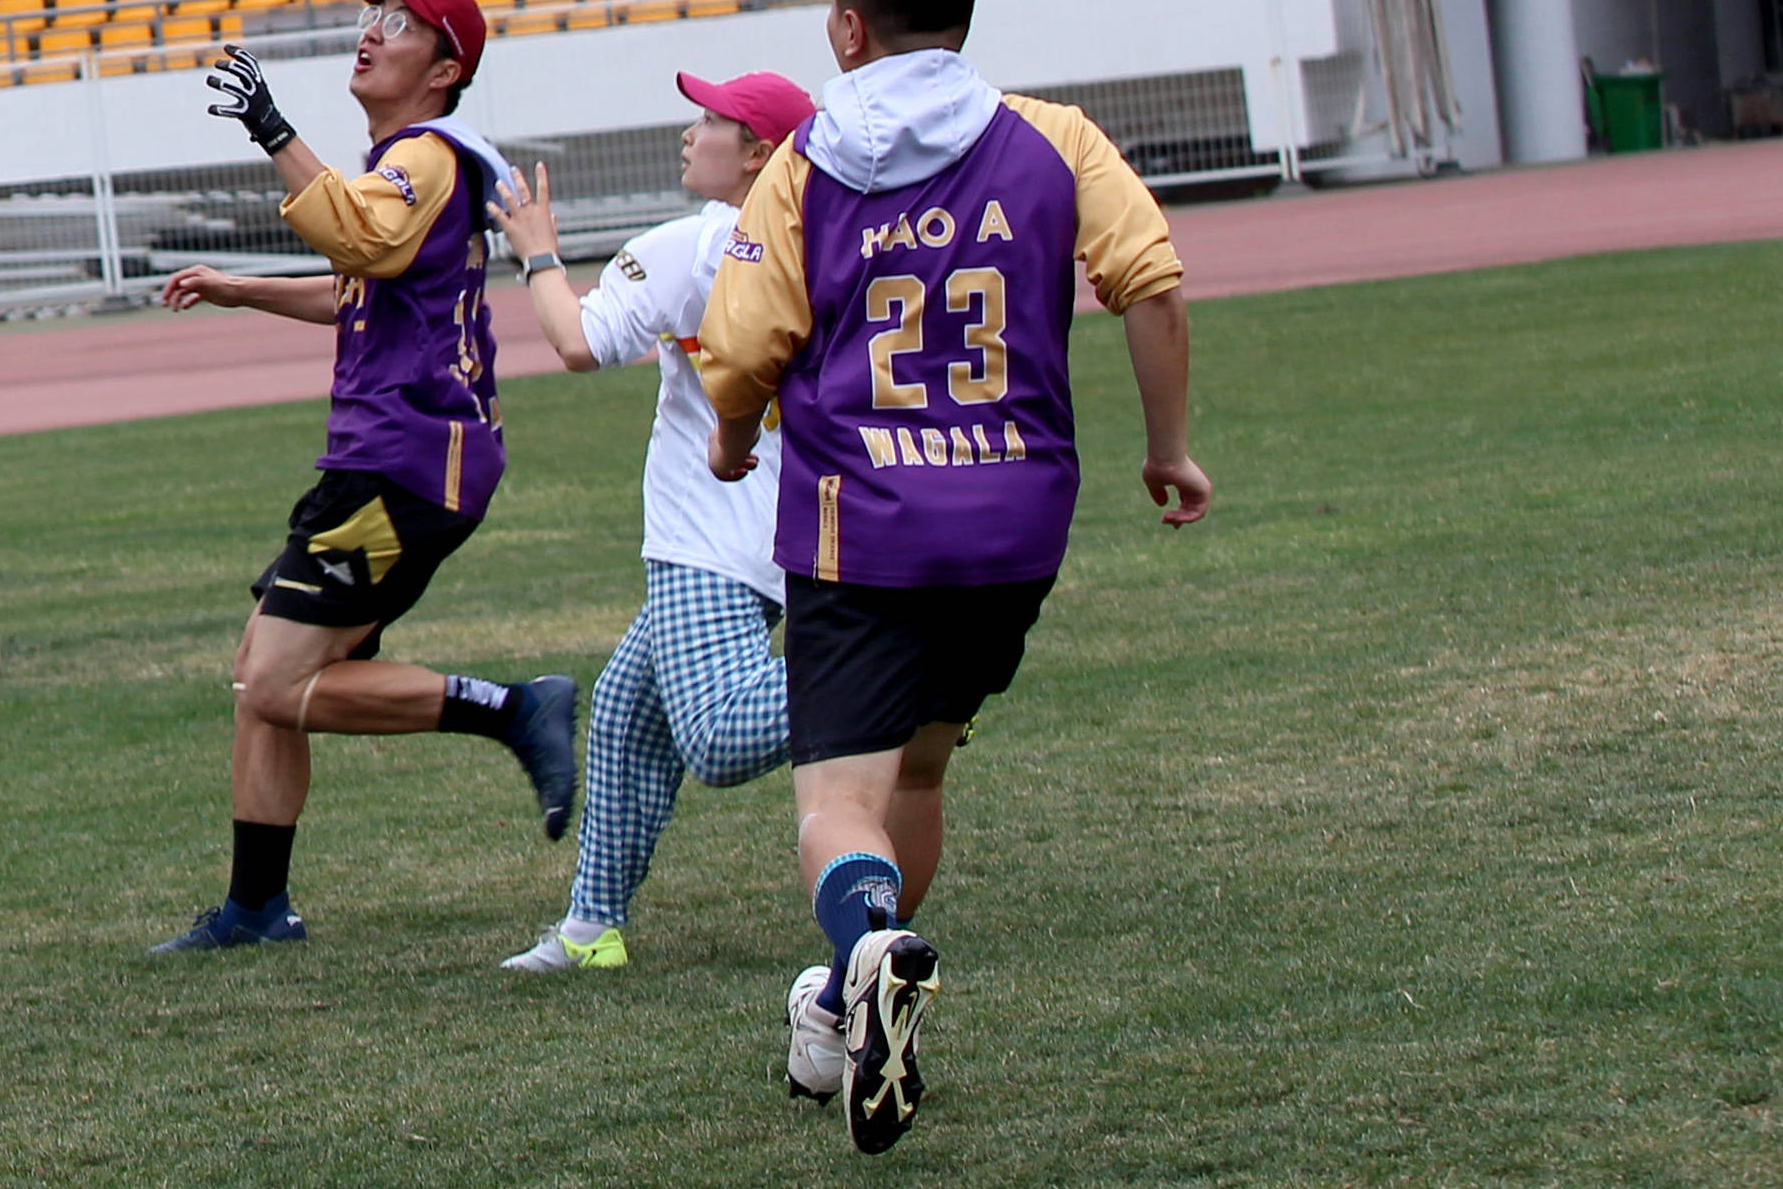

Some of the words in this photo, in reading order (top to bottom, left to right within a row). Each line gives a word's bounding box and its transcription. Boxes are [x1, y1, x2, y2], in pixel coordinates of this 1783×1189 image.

[861, 212, 956, 259] HAO
[976, 200, 1013, 242] A
[866, 266, 1008, 410] 23
[858, 421, 1026, 469] WAGALA
